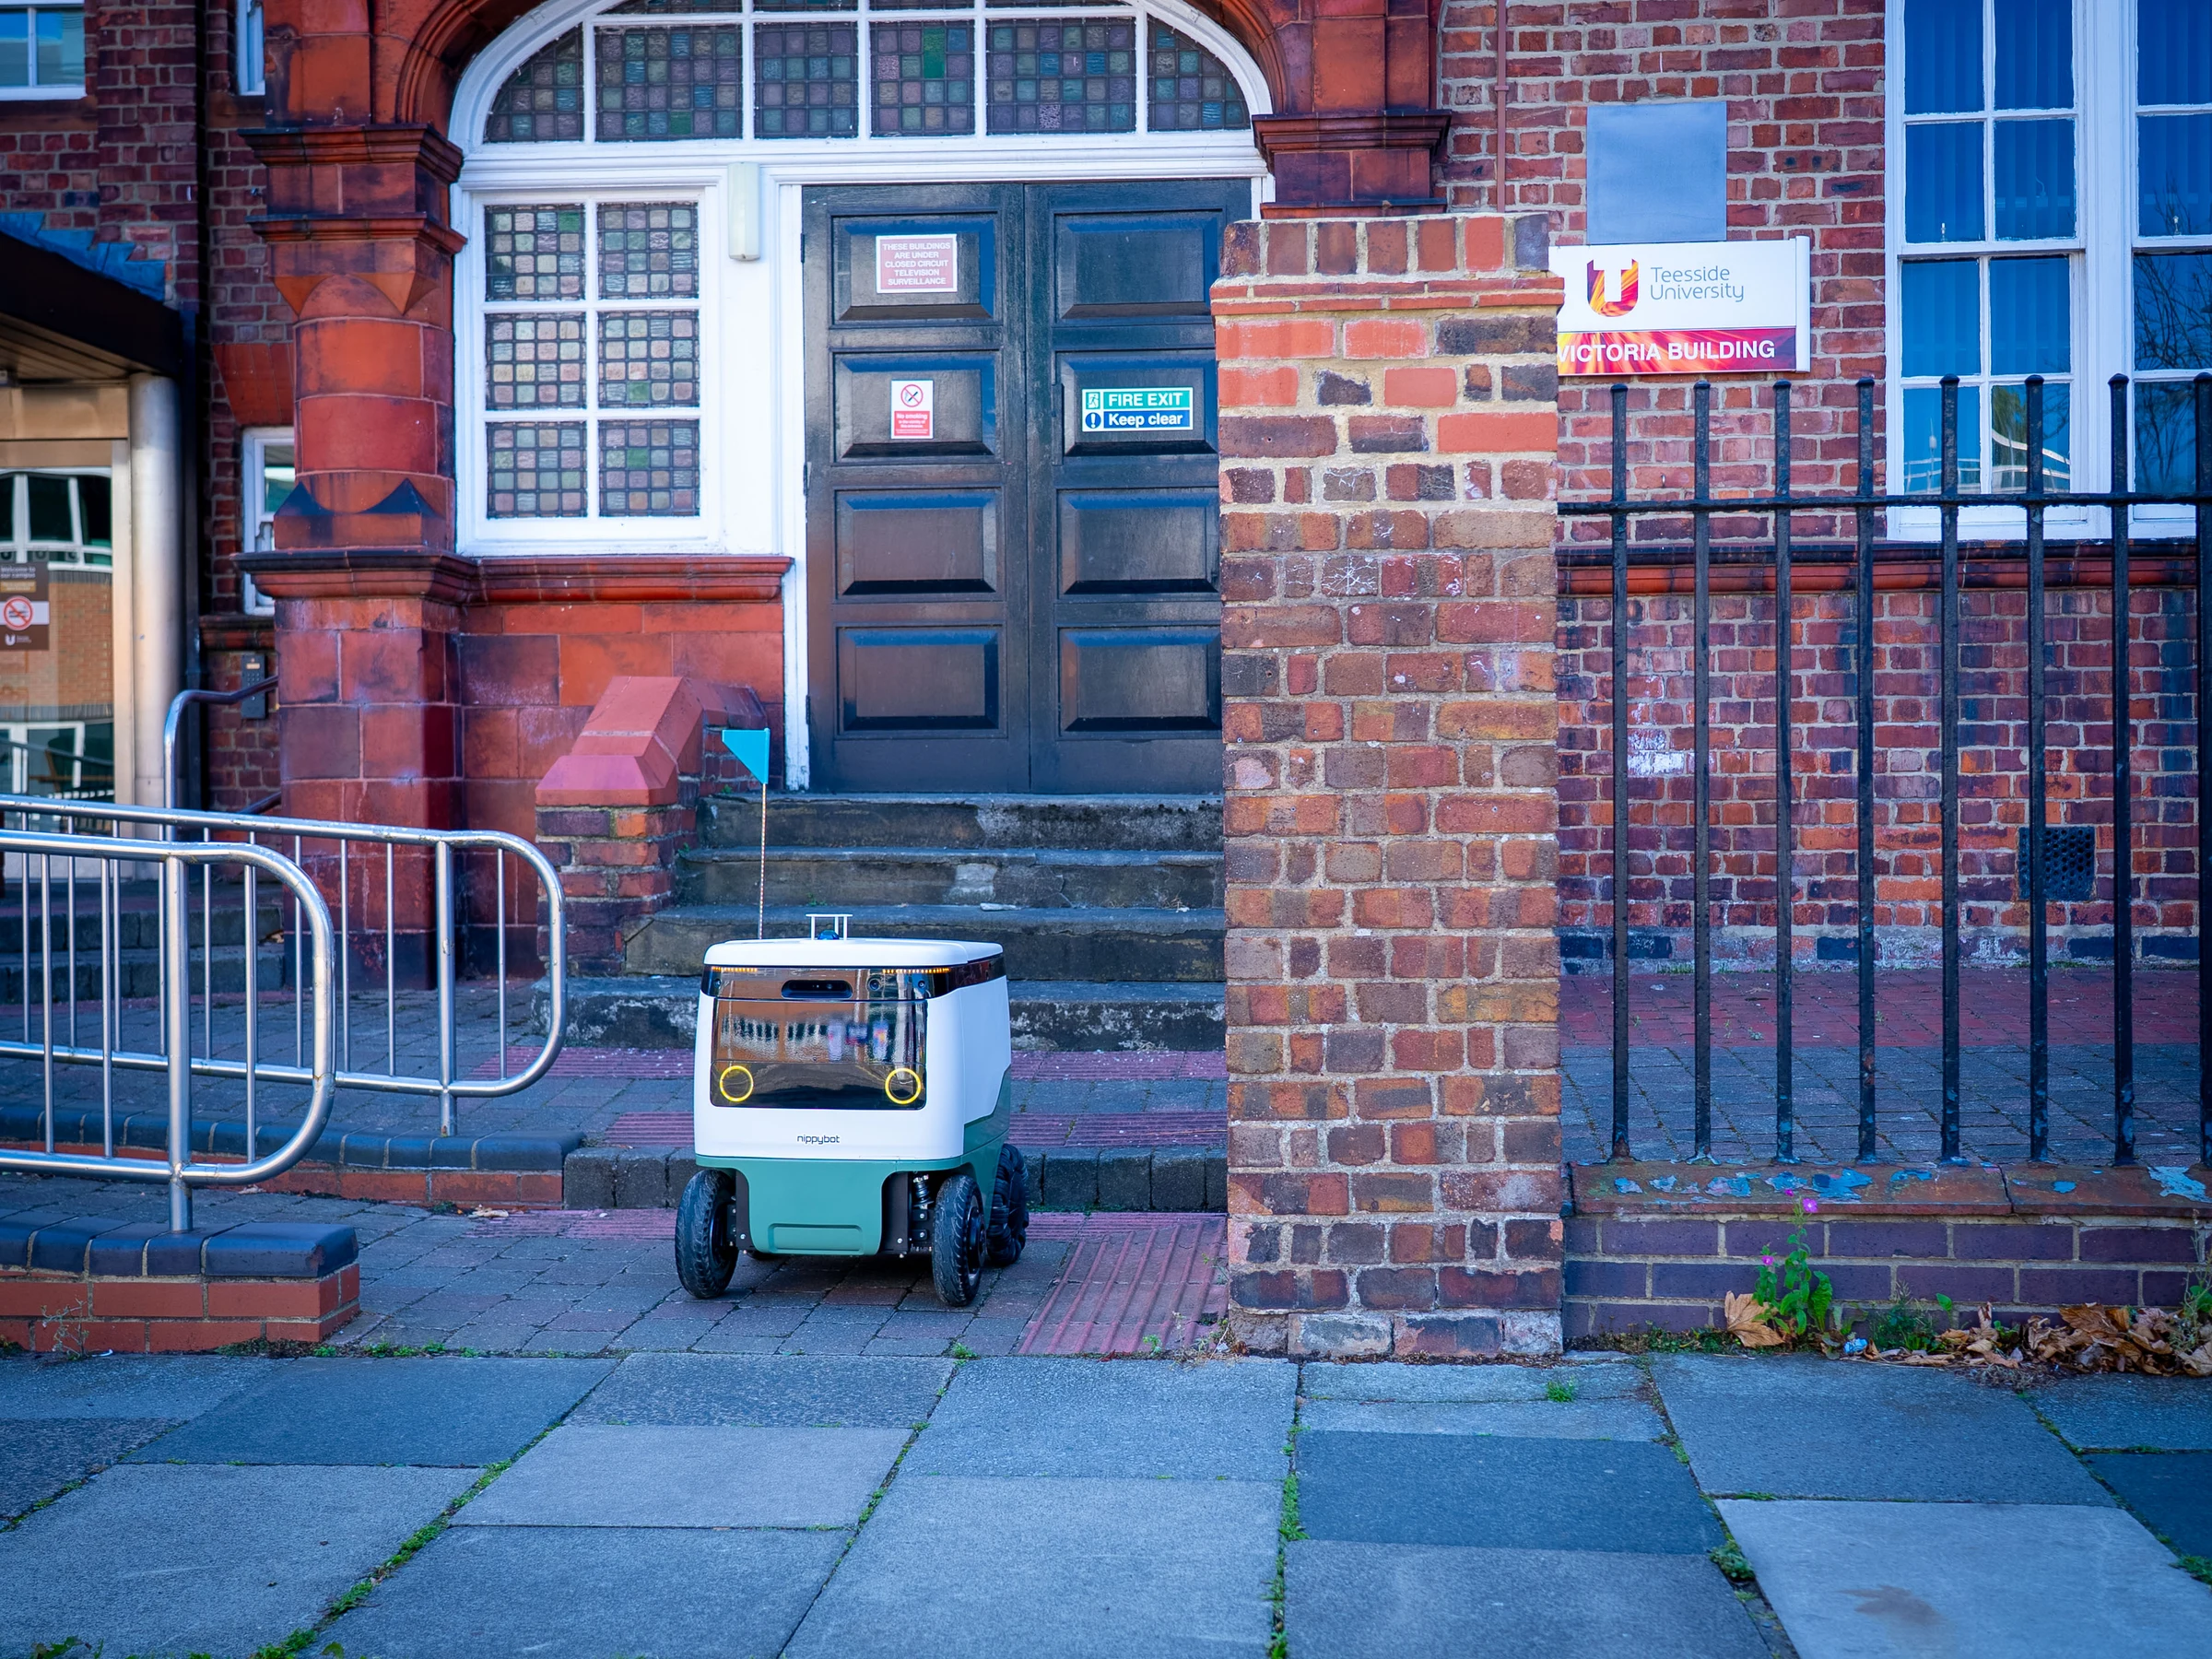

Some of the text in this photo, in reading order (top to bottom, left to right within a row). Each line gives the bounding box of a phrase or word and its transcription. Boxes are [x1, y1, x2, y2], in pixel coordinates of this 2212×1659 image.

[885, 259, 948, 268] CLOSED CIRCUIT
[894, 268, 940, 276] TELEVISION
[1650, 265, 1730, 283] Teesside
[888, 277, 947, 286] SURVEILLANCE
[1650, 283, 1745, 303] University
[1558, 339, 1776, 363] VICTORIA BUILDING
[1108, 393, 1183, 406] FIRE EXIT
[1108, 412, 1183, 429] Keep clear
[796, 1134, 841, 1145] nippybot
